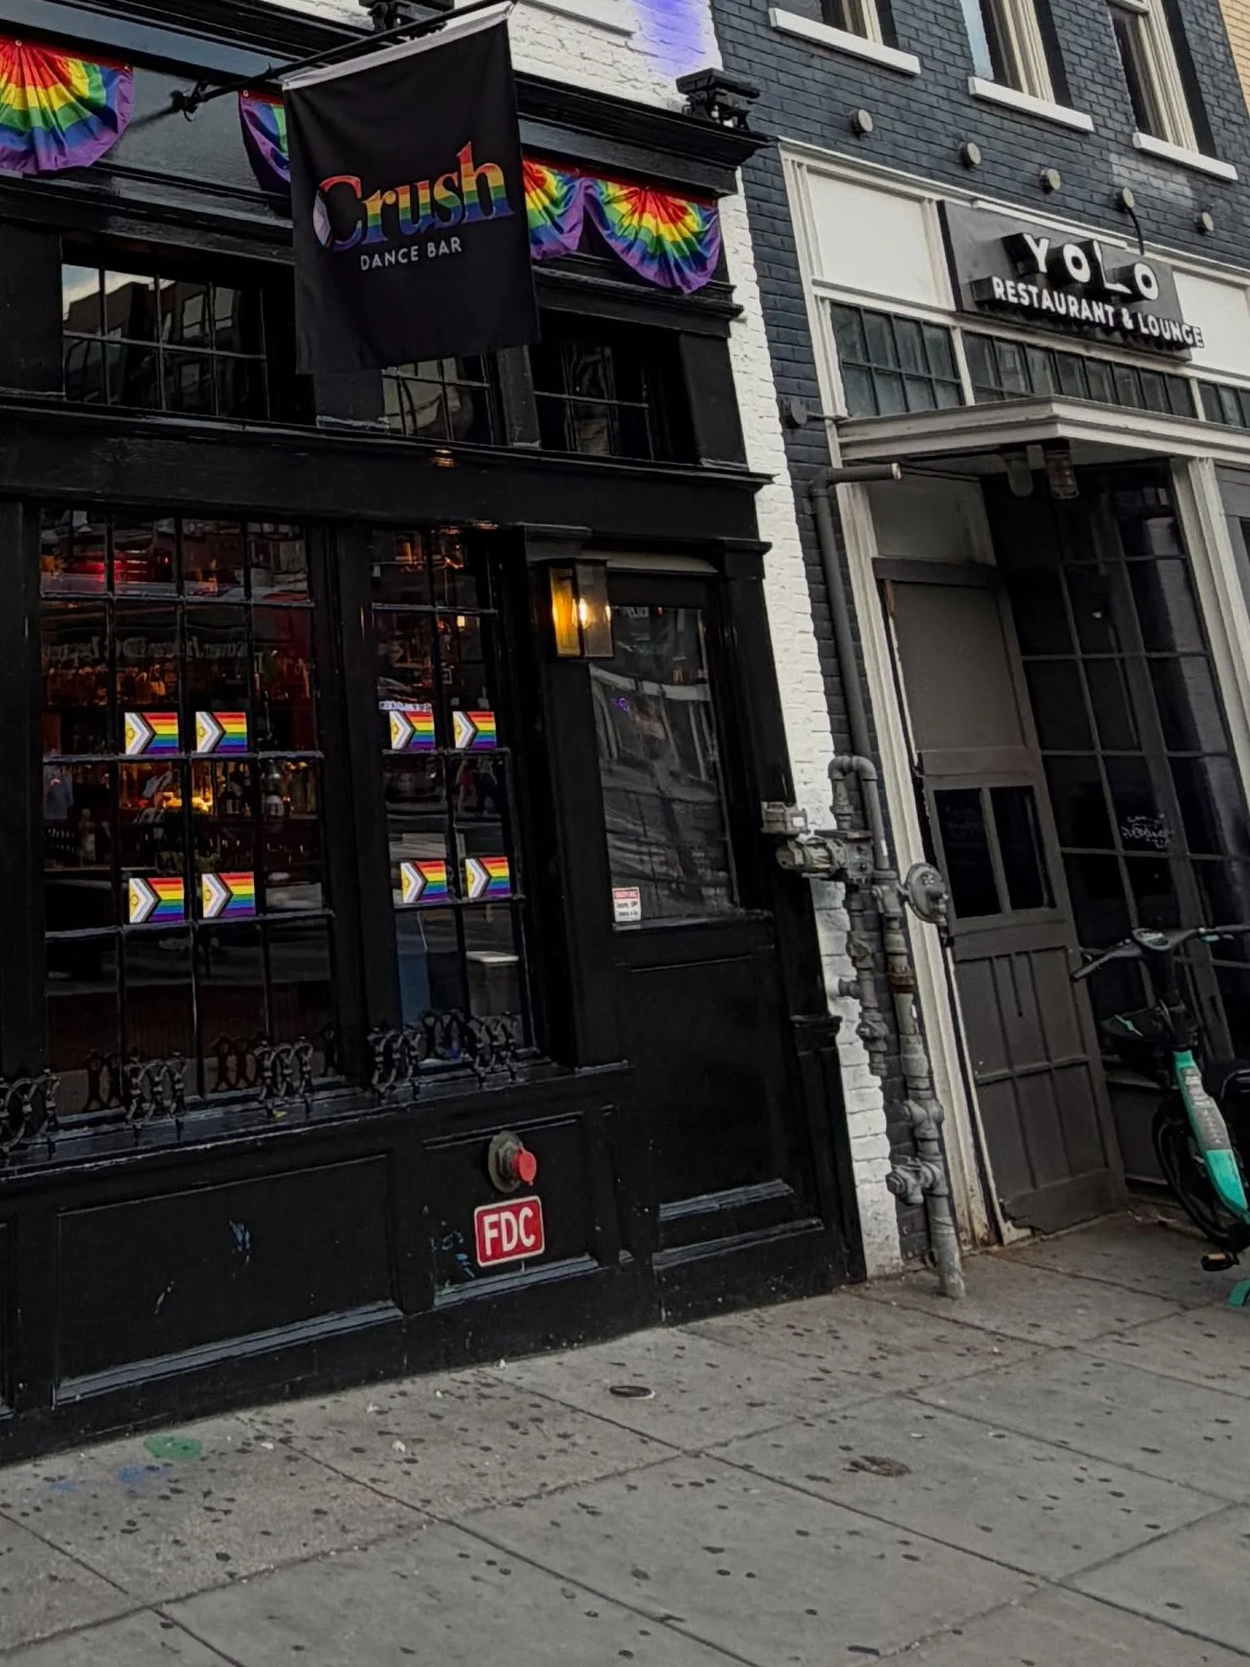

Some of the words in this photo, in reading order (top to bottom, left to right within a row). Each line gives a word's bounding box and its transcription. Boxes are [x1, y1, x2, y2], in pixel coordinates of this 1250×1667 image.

[312, 141, 515, 252] Crush
[359, 245, 419, 272] DANCE
[427, 236, 463, 259] BAR
[1022, 233, 1160, 301] YOLO
[991, 275, 1116, 328] RESTAURANT
[1120, 307, 1135, 331] &
[1137, 313, 1205, 349] LOUNGE
[482, 1206, 536, 1257] FDC
